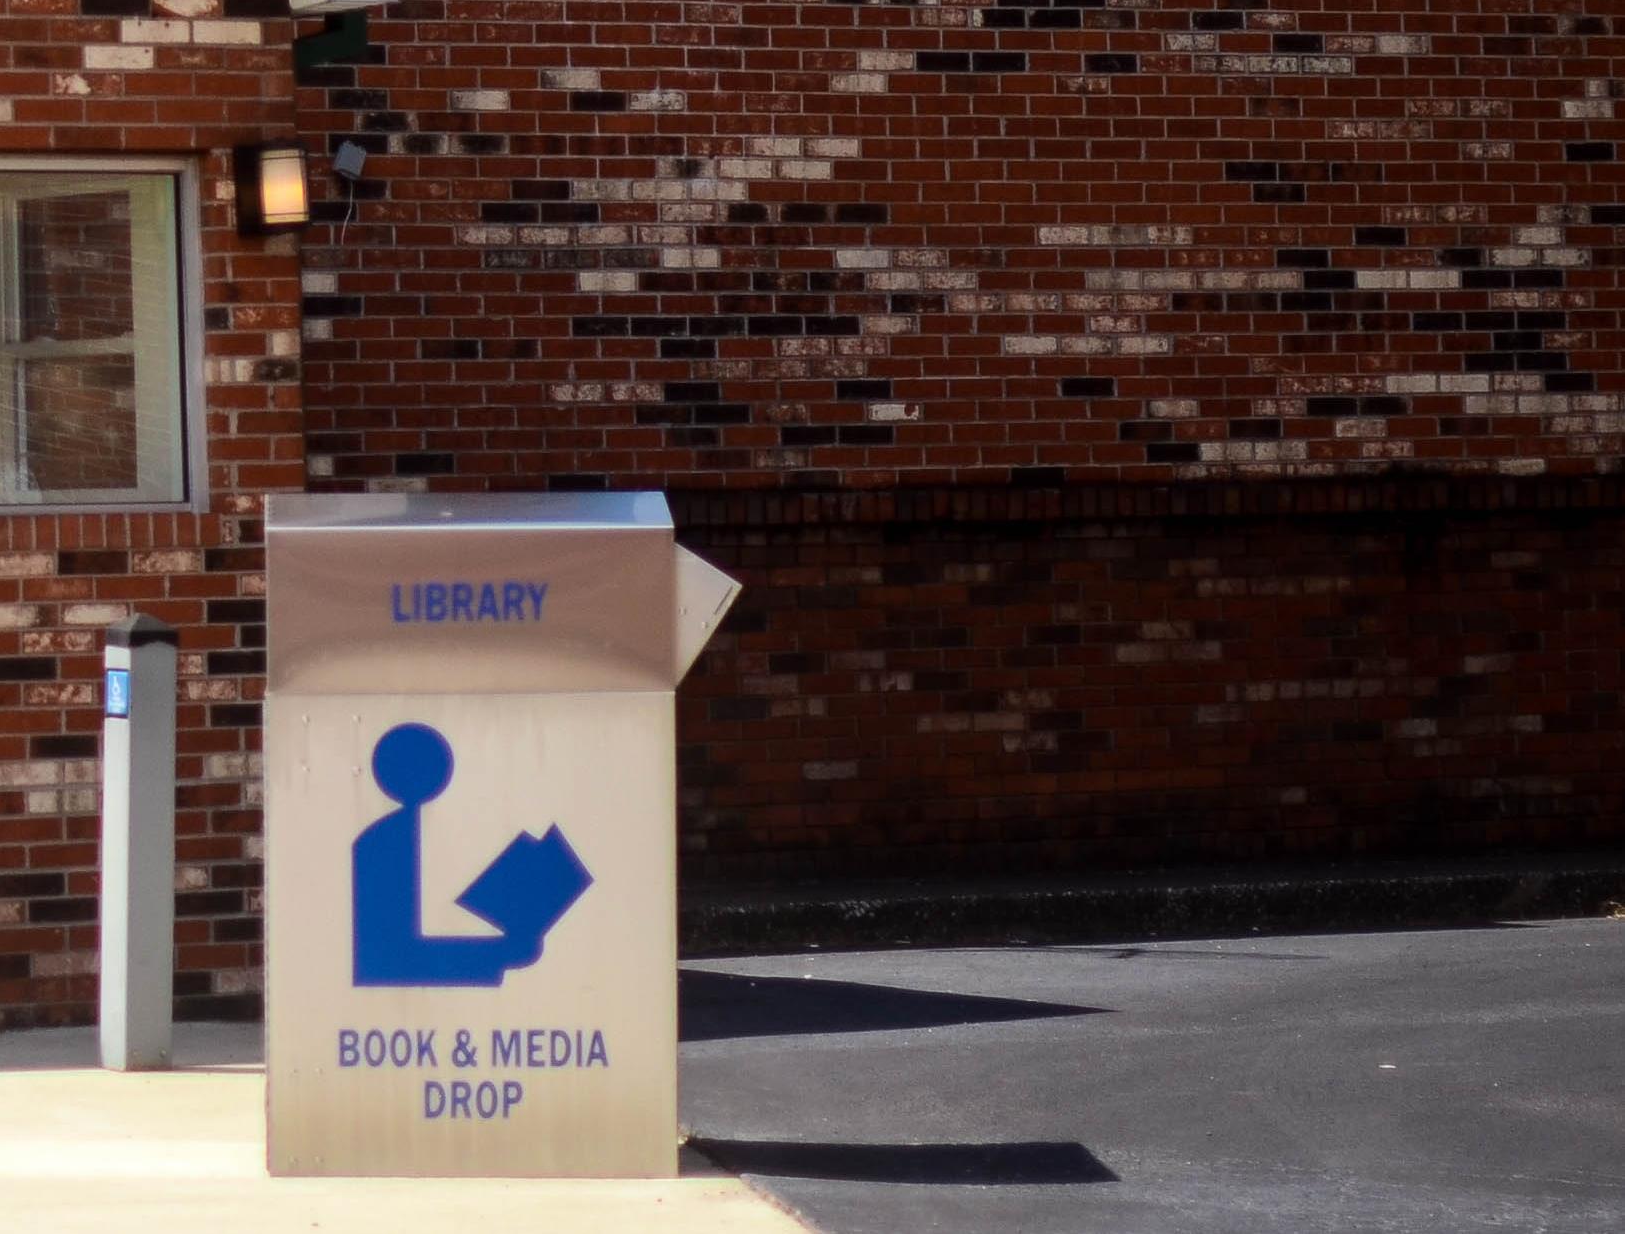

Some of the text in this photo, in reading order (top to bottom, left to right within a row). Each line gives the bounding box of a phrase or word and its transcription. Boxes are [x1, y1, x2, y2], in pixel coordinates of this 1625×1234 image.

[391, 582, 549, 623] LIBRARY
[338, 1029, 609, 1068] BOOK & MEDIA
[424, 1080, 523, 1119] DROP
